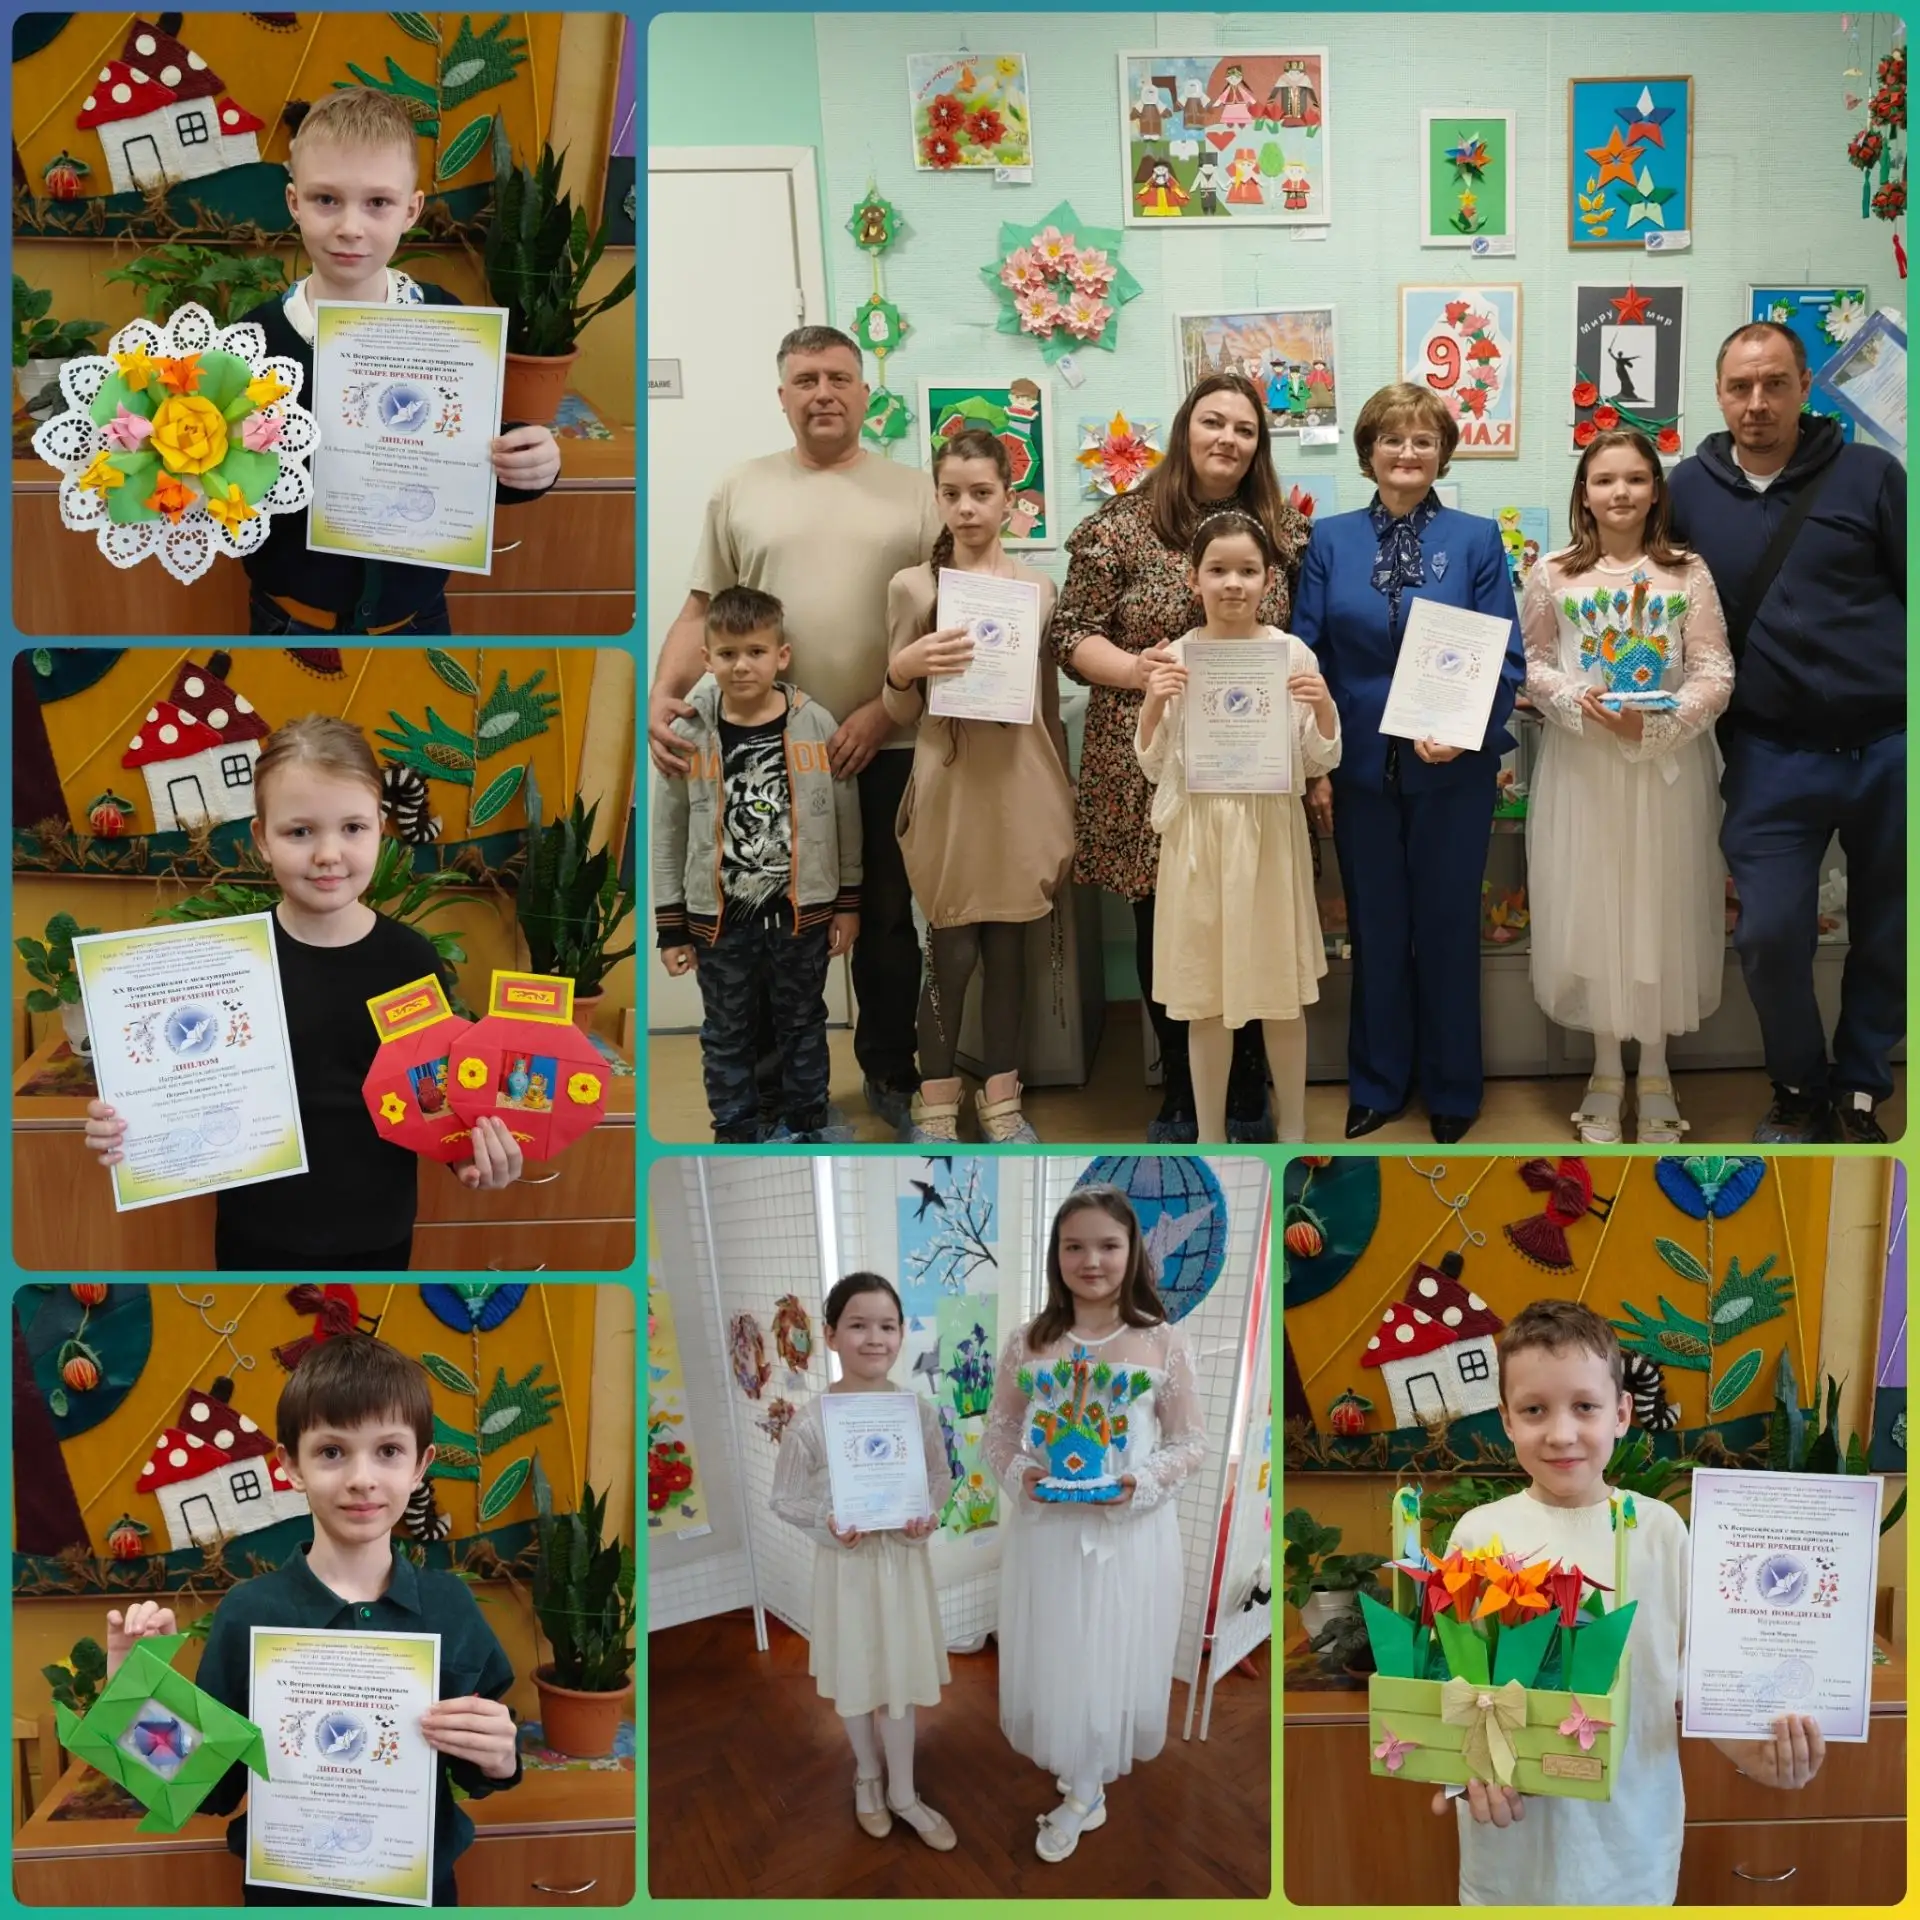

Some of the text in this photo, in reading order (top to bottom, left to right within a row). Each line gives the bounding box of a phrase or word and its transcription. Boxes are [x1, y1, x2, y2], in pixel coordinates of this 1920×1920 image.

[1580, 309, 1672, 334] Миру мир
[1426, 336, 1461, 390] 9
[389, 371, 433, 380] ВРЕМЕНИ
[377, 435, 424, 447] ДИПЛОМ
[169, 990, 213, 1003] ВРЕМЕНИ
[171, 1056, 219, 1072] ДИПЛОМ
[1767, 1542, 1810, 1551] ВРЕМЕНИ
[1727, 1607, 1831, 1619] ДИПЛОМ ПОБЕДИТЕЛЯ
[326, 1698, 369, 1708] ВРЕМЕНИ
[315, 1764, 362, 1775] ДИПЛОМ
